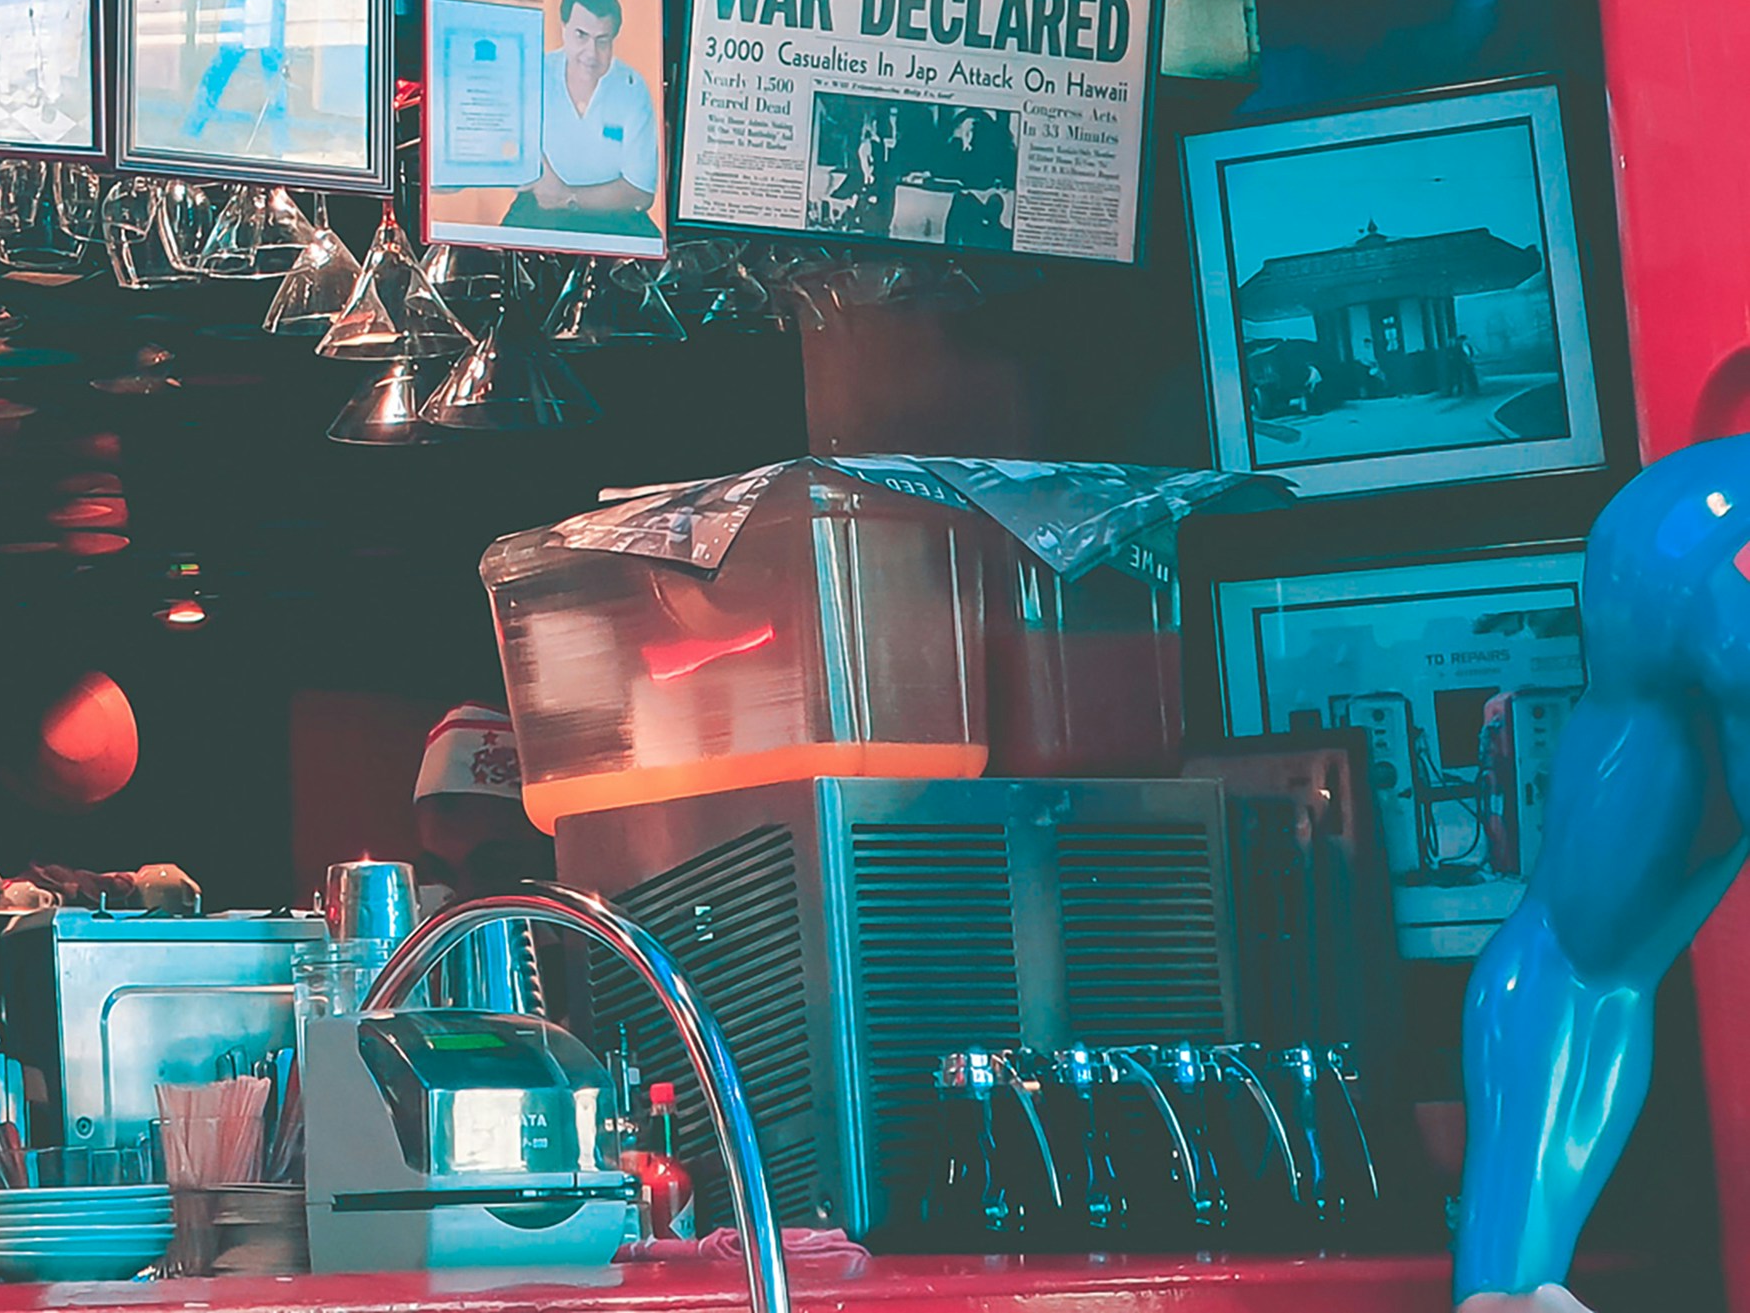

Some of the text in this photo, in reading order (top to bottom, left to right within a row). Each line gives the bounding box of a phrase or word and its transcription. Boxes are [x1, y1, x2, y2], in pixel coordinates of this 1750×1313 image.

[702, 69, 748, 93] Nearly
[756, 74, 794, 94] 1,500
[705, 36, 765, 64] 3,000
[777, 40, 868, 74] Casualties
[877, 51, 894, 77] In
[904, 54, 938, 86] Jap
[948, 59, 1014, 90] Attack
[1024, 67, 1056, 95] On
[1066, 71, 1129, 103] Hawaii
[700, 91, 791, 116] Feared Dead
[1022, 98, 1118, 124] Congress Acts
[1022, 121, 1119, 146] In 33 Minutes
[1426, 649, 1511, 666] TO REPAIRS
